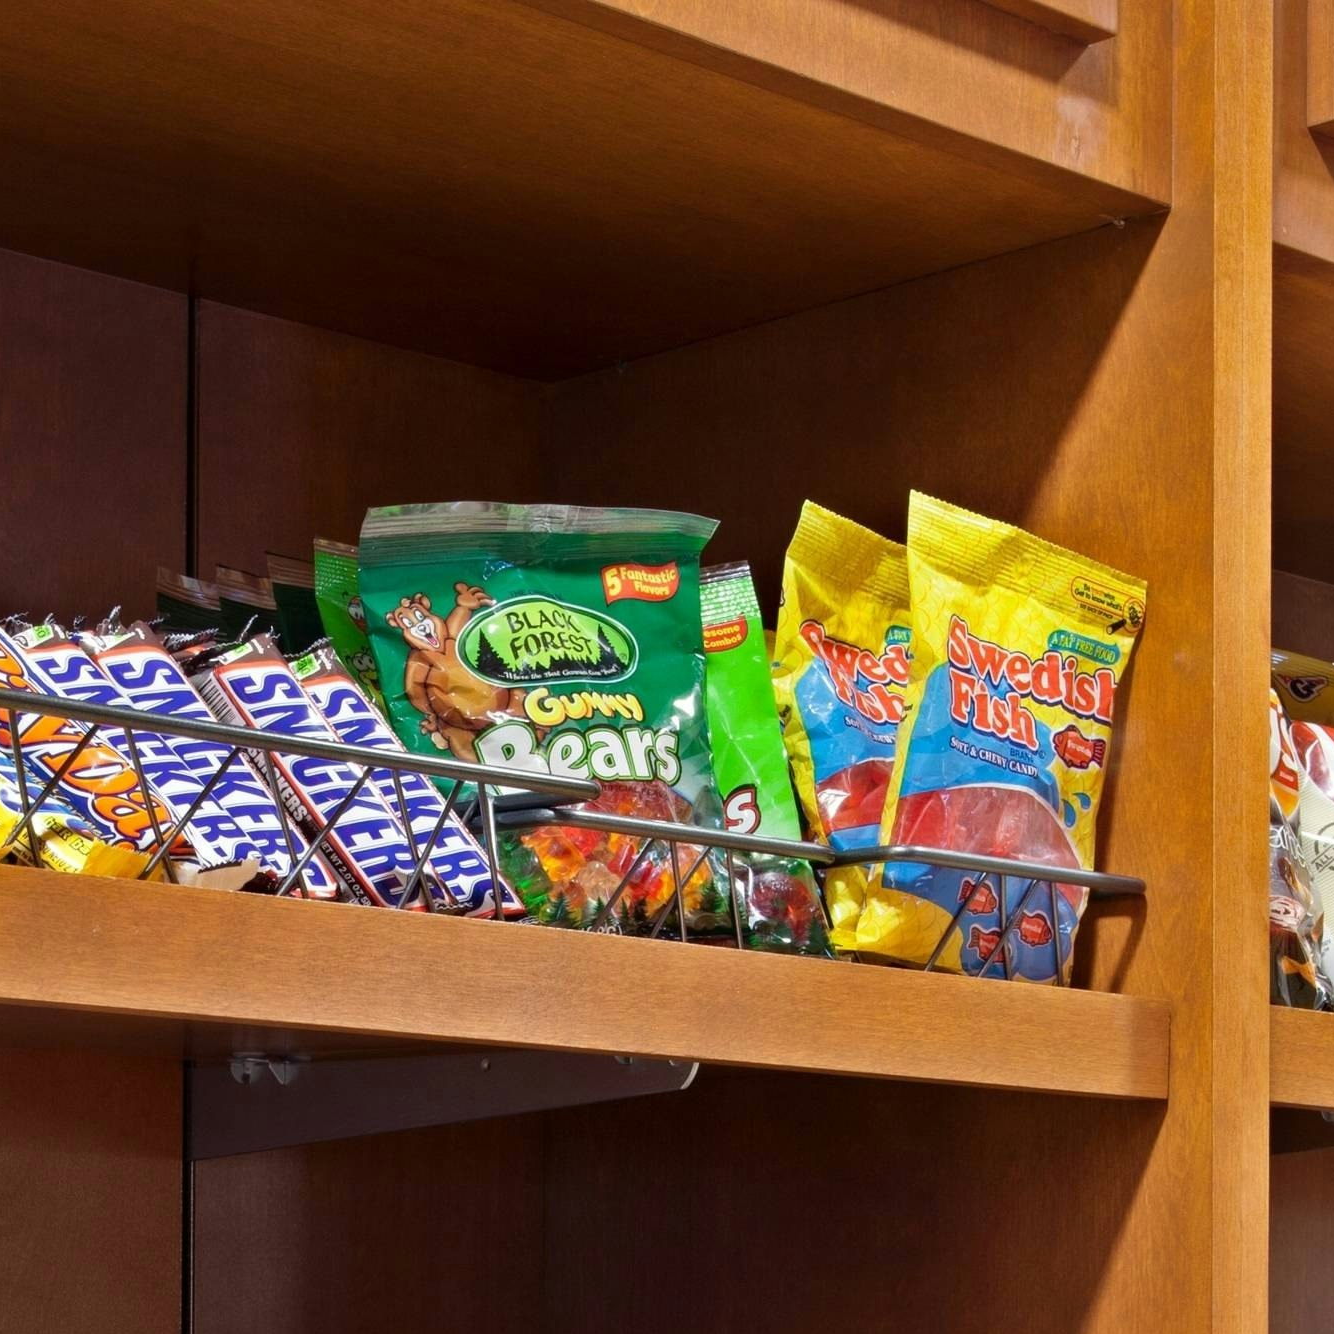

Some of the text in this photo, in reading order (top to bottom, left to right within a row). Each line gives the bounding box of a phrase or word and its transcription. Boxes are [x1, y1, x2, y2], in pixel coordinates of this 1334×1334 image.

[605, 565, 677, 597] 5 Fantastic
[633, 581, 671, 598] Flavors
[505, 610, 578, 635] BLACK
[508, 631, 593, 661] FOREST
[1075, 640, 1095, 658] FREE
[1094, 645, 1116, 664] FOOD
[949, 667, 1040, 752] Fish
[474, 720, 682, 795] Bears
[950, 736, 970, 755] SOFT
[978, 747, 1009, 772] CHEWY
[1008, 759, 1040, 779] CANDY
